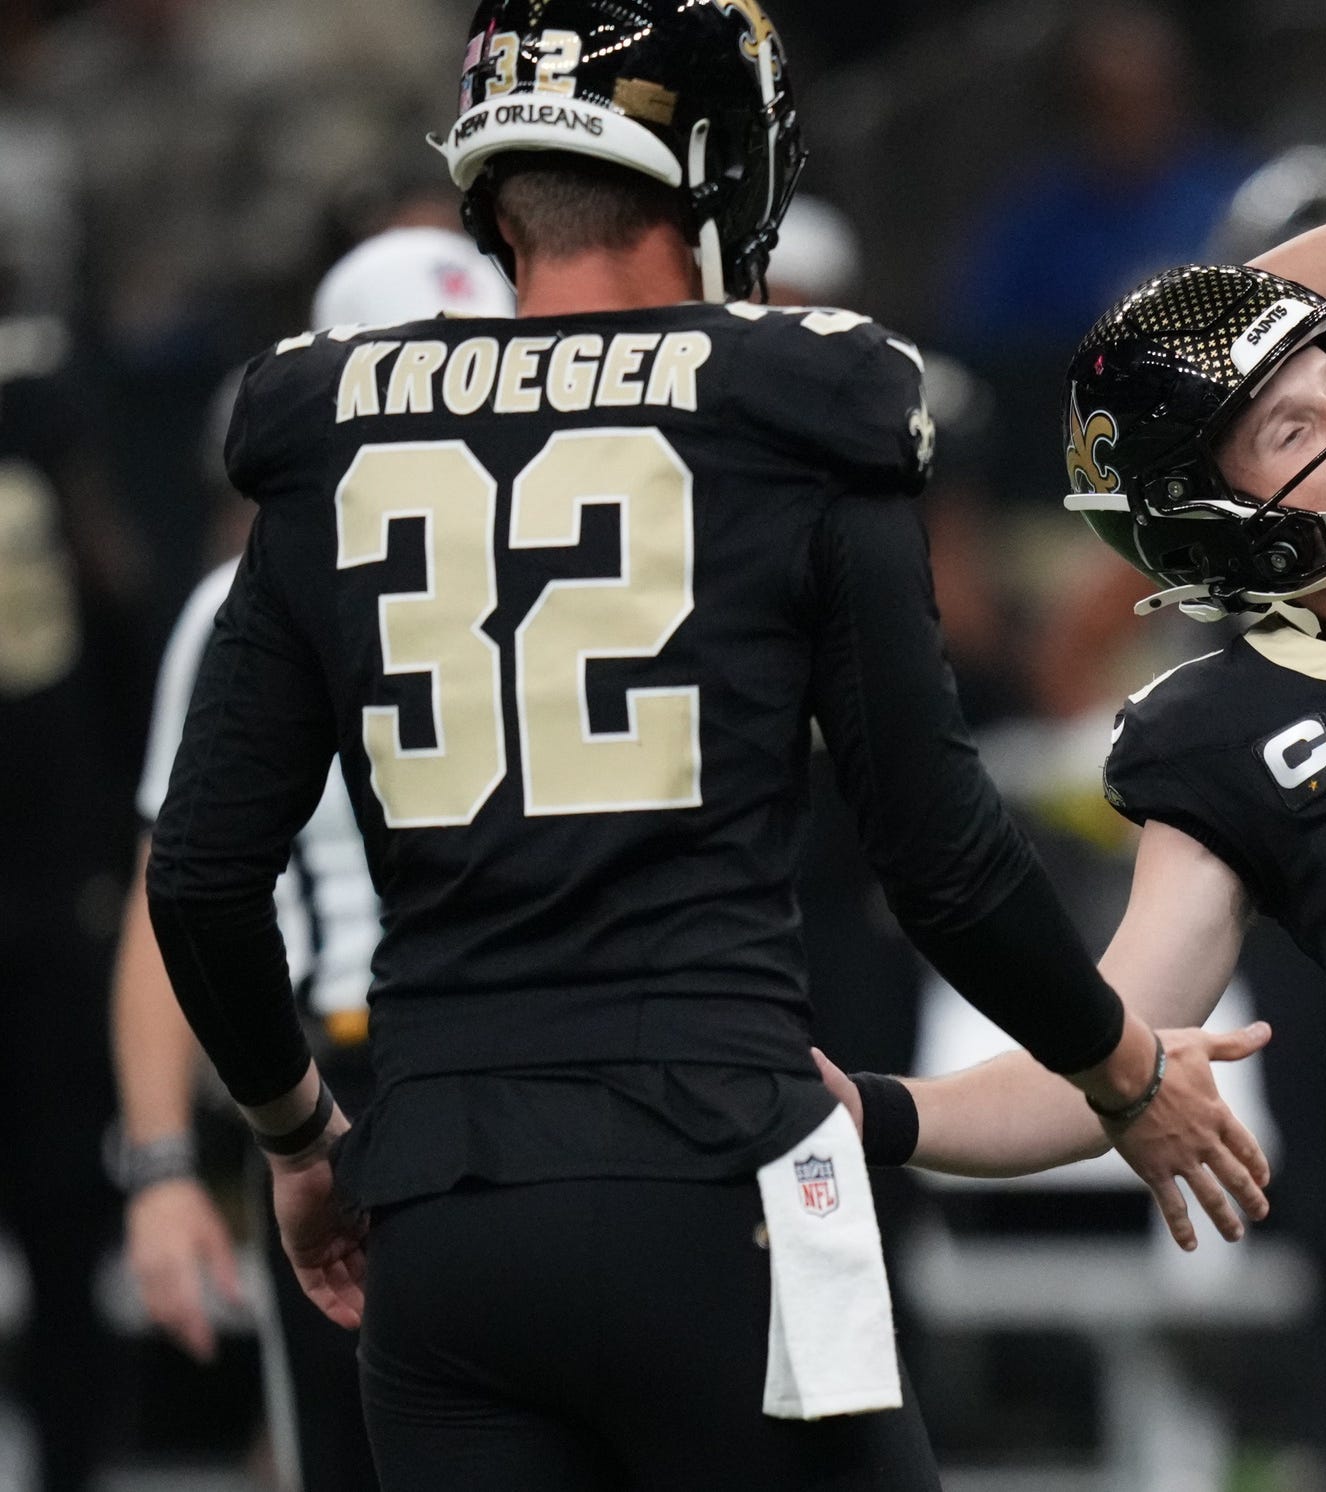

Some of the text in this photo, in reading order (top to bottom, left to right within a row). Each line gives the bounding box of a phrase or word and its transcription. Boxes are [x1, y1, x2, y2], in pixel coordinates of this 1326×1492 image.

[485, 29, 582, 101] 32
[454, 104, 603, 147] NEW ORLEANS
[1246, 305, 1288, 346] SAINTS
[336, 330, 711, 423] KROEGER
[335, 426, 702, 828] 32
[802, 1181, 835, 1211] NFL
